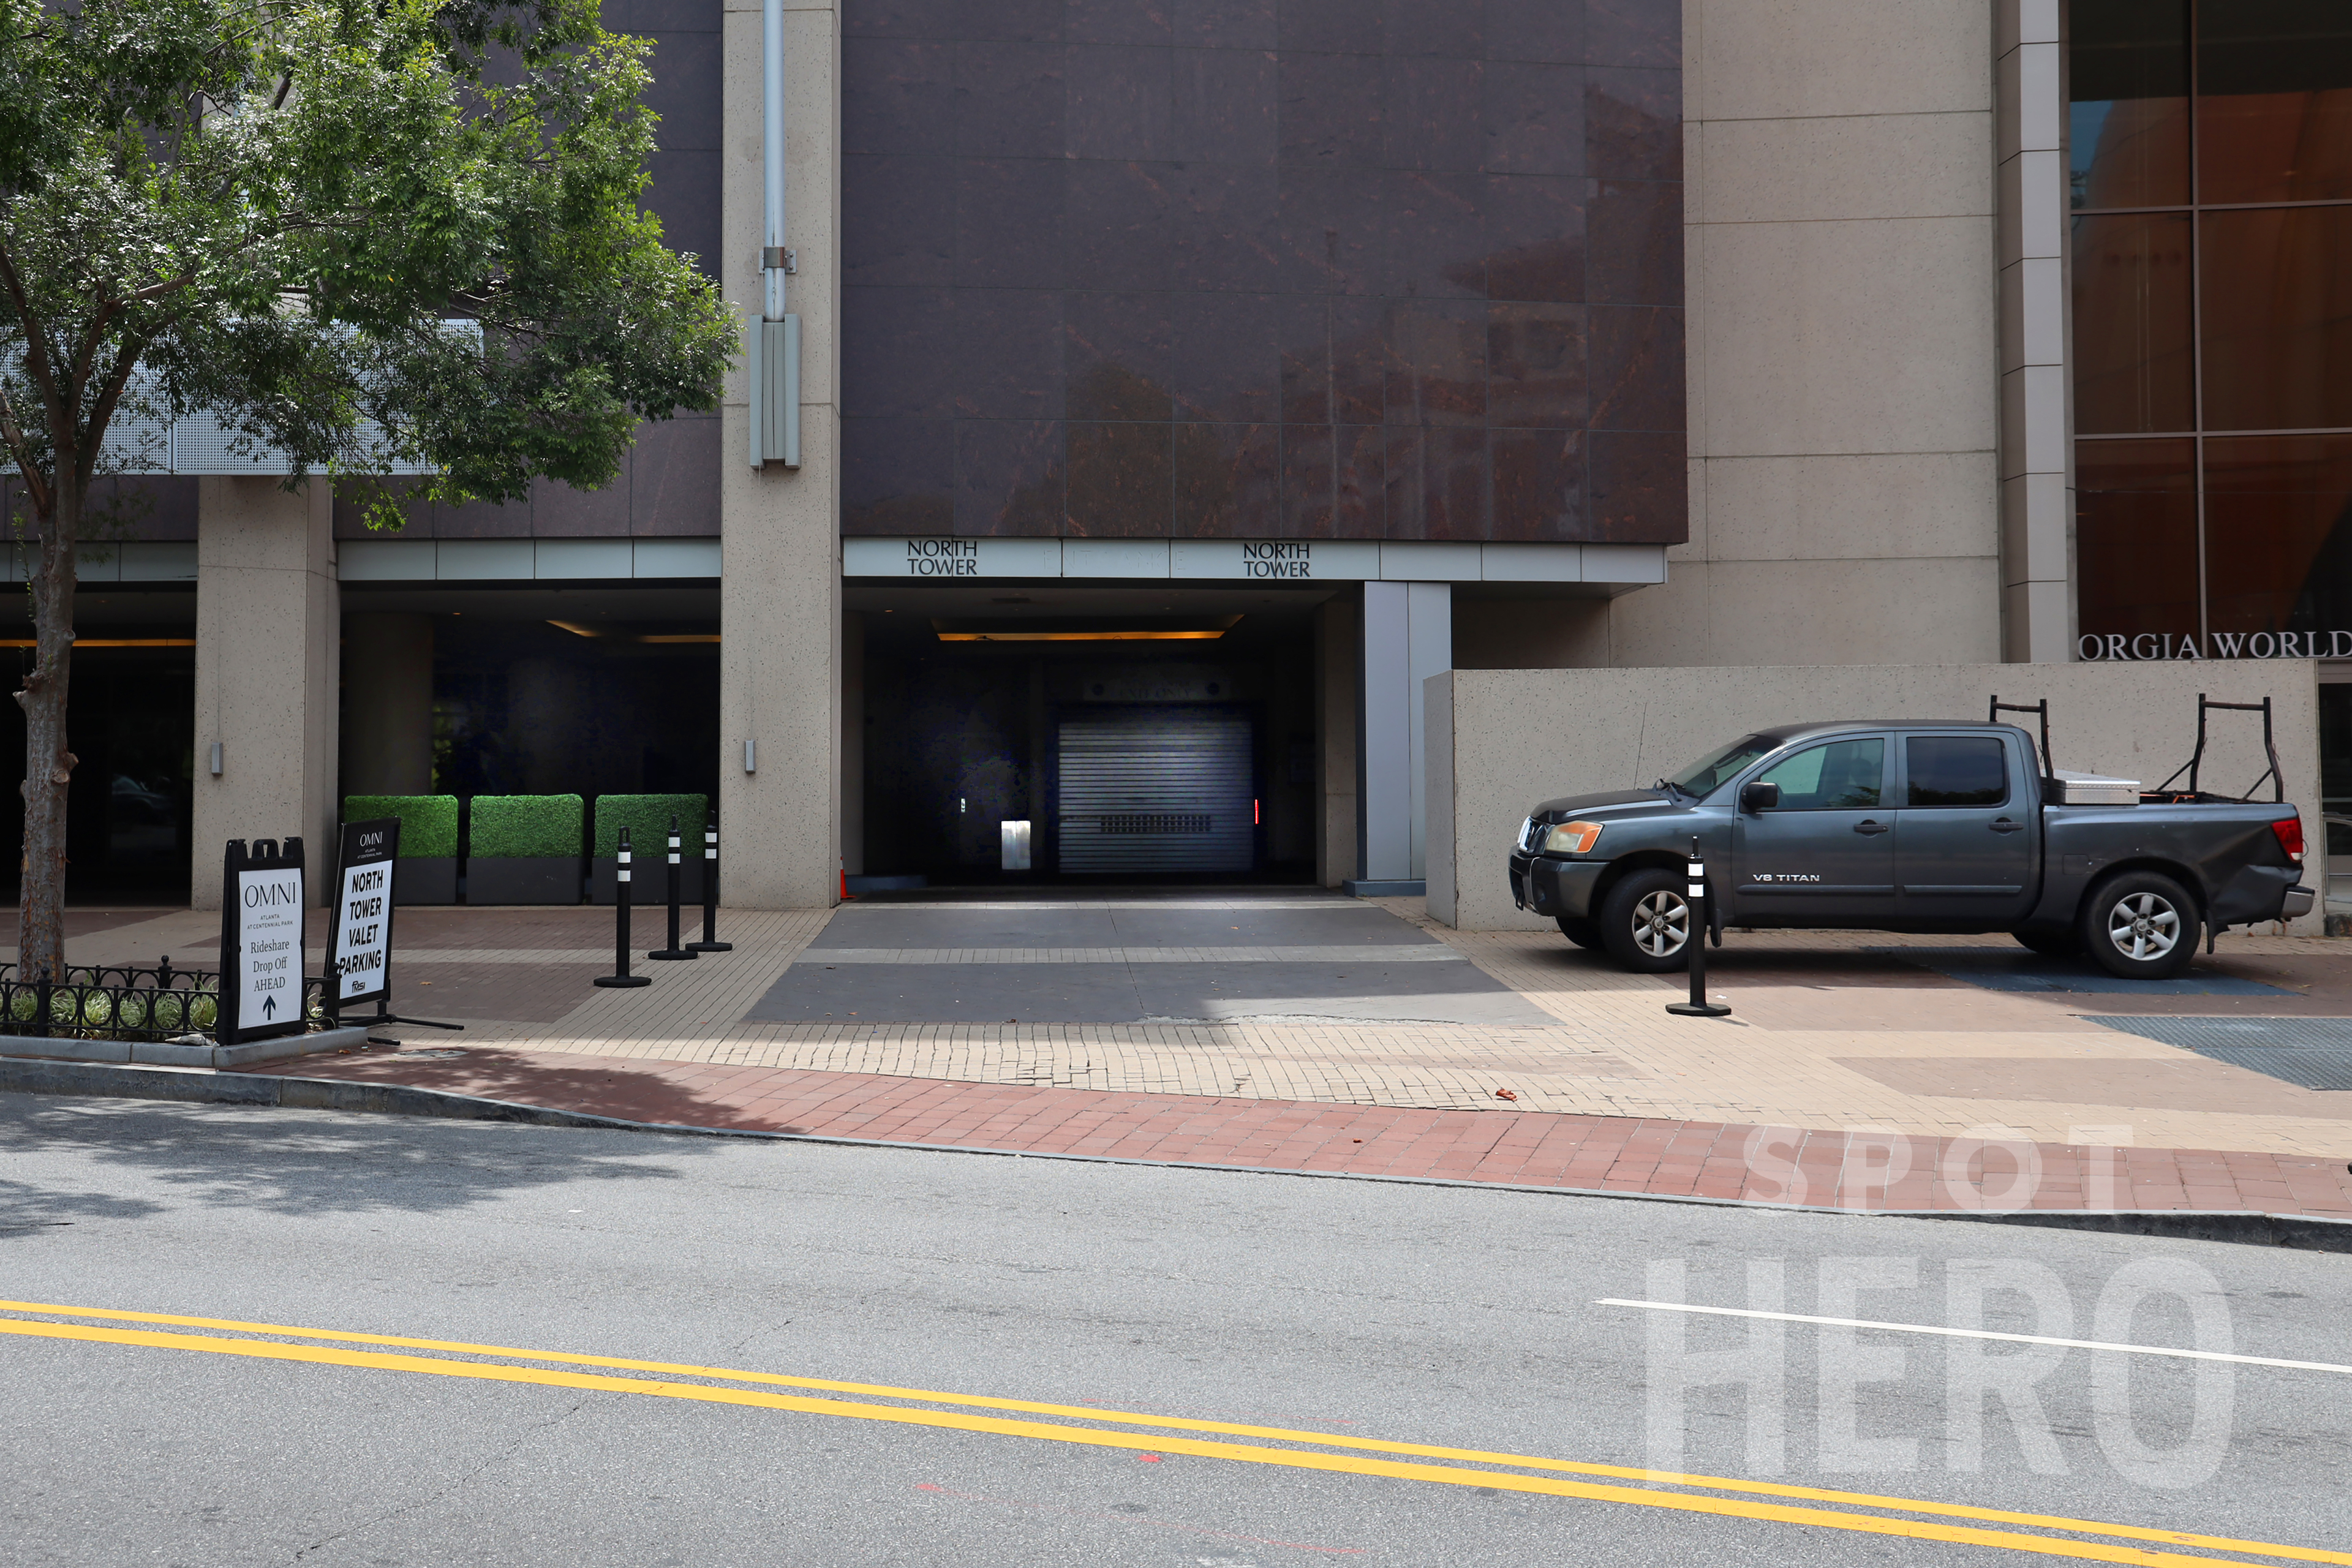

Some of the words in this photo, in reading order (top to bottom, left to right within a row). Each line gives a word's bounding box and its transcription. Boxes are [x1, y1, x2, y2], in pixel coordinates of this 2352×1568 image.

[908, 540, 977, 557] NORTH
[1243, 543, 1310, 559] NORTH
[907, 558, 978, 575] TOWER
[1243, 560, 1311, 578] TOWER
[2211, 630, 2352, 659] WORLD
[360, 831, 383, 846] OMNI
[352, 869, 383, 894] NORTH
[245, 882, 296, 908] OMNI
[350, 896, 382, 921] TOWER
[349, 924, 379, 948] VALET
[251, 938, 290, 954] Rideshare
[253, 960, 273, 974] Drop
[274, 956, 288, 970] Off
[339, 949, 382, 976] PARKING
[254, 976, 285, 992] AHEAD
